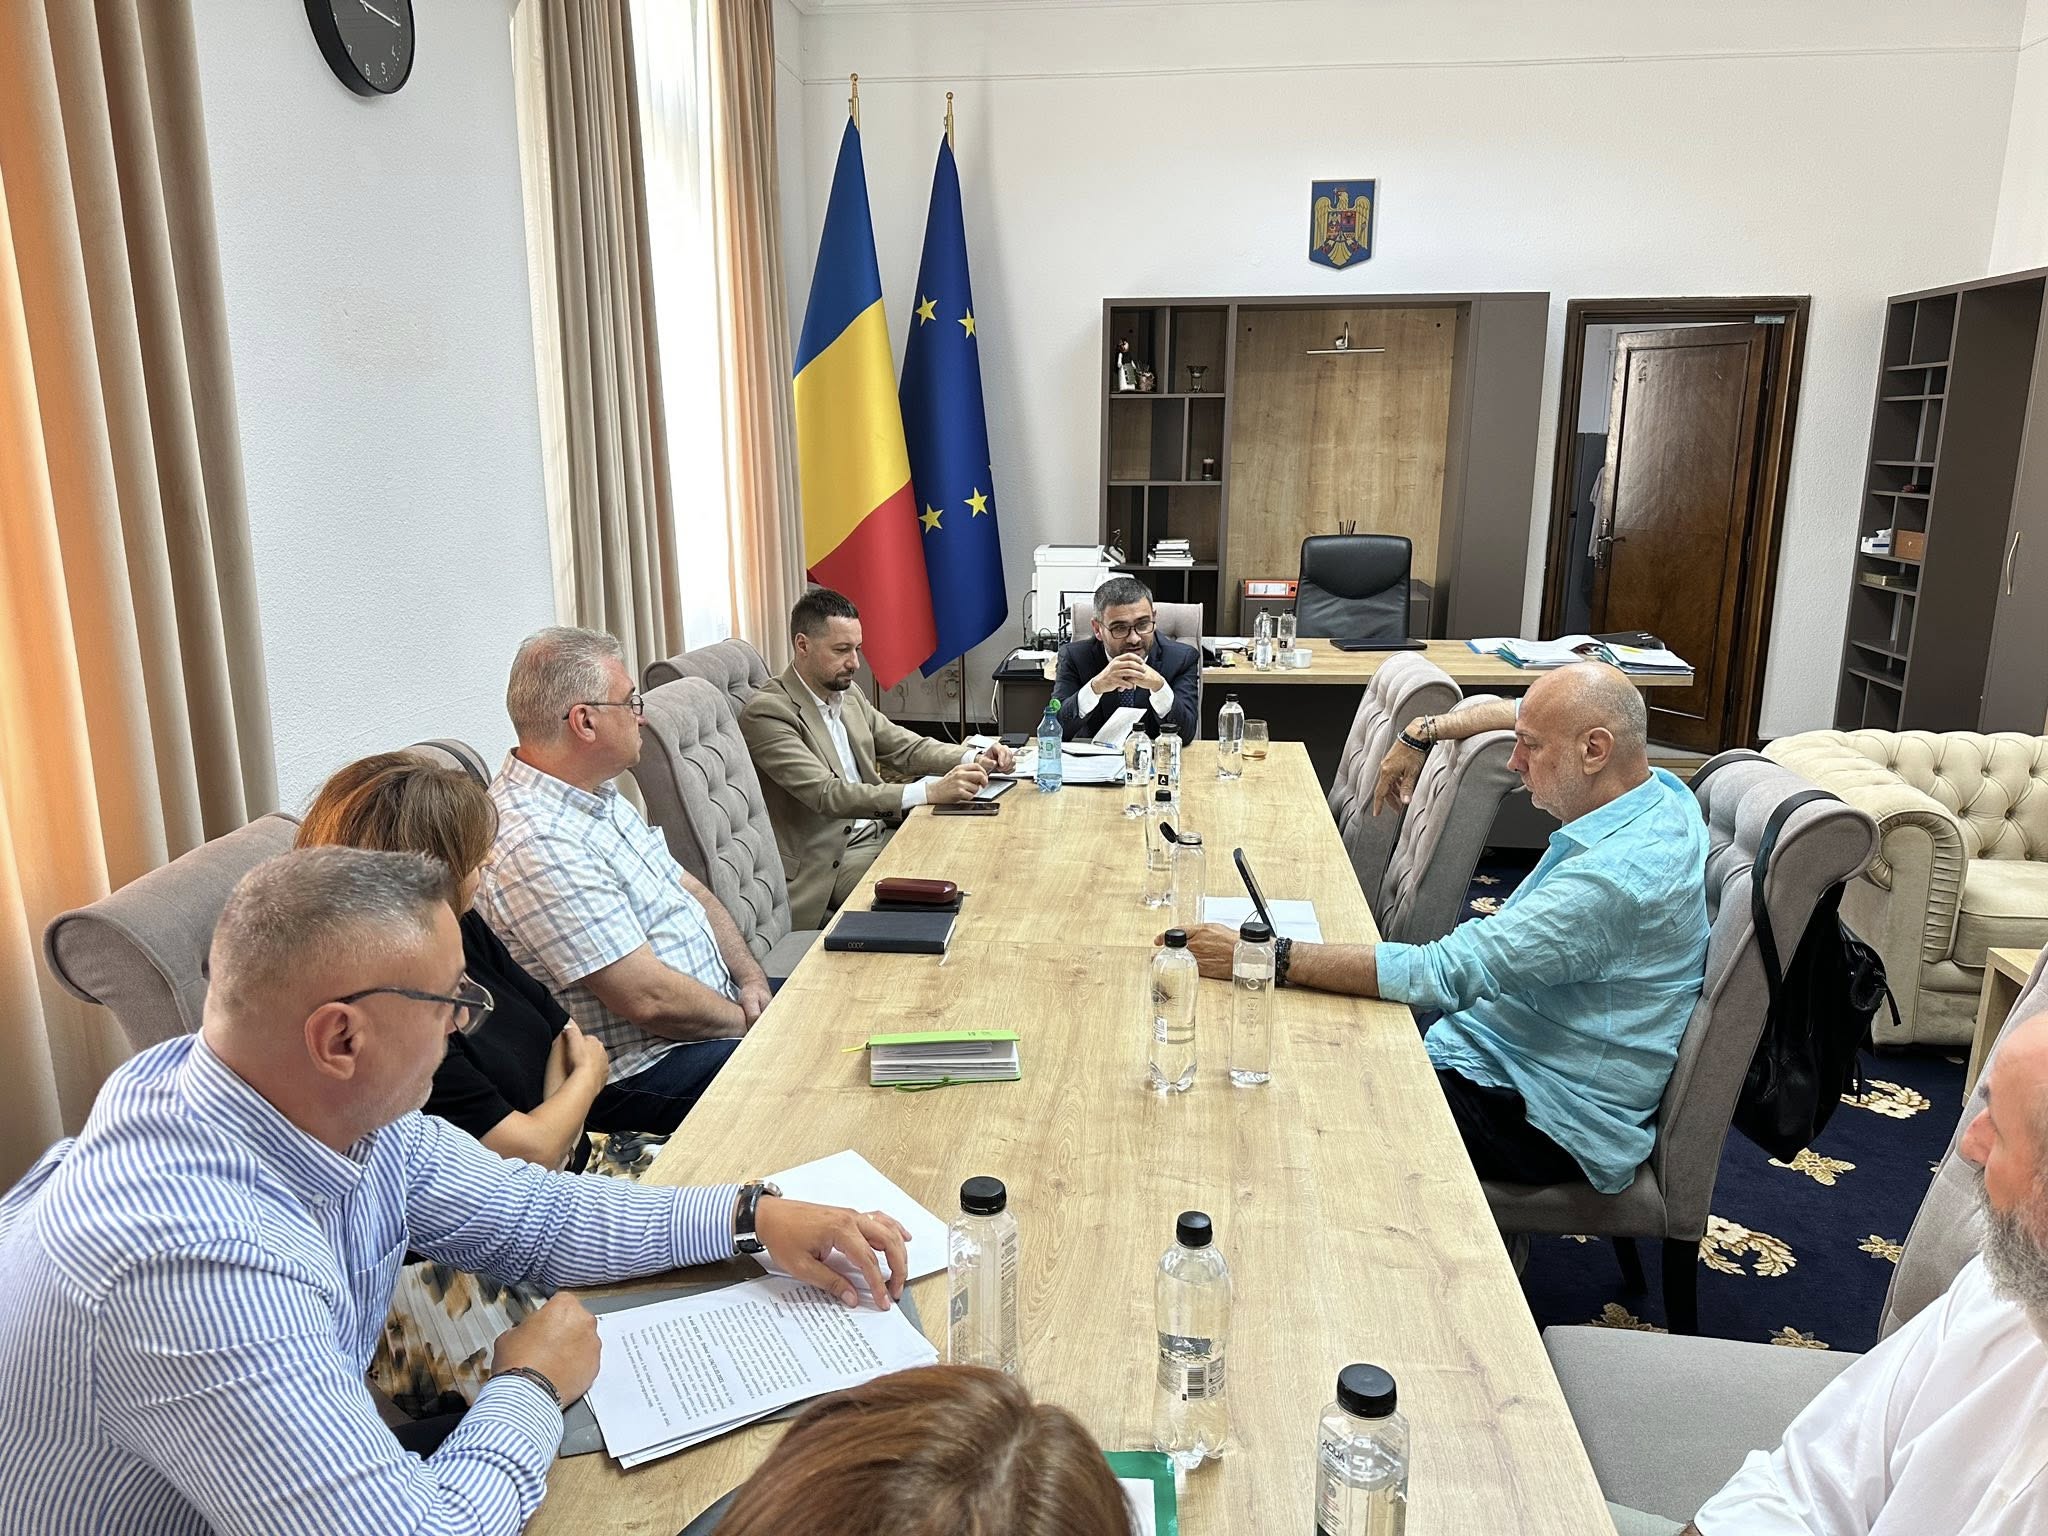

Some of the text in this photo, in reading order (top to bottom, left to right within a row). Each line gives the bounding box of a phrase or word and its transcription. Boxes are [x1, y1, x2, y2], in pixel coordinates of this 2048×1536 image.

[365, 63, 371, 77] 6
[380, 62, 387, 75] 5
[1322, 1439, 1345, 1463] AQUA
